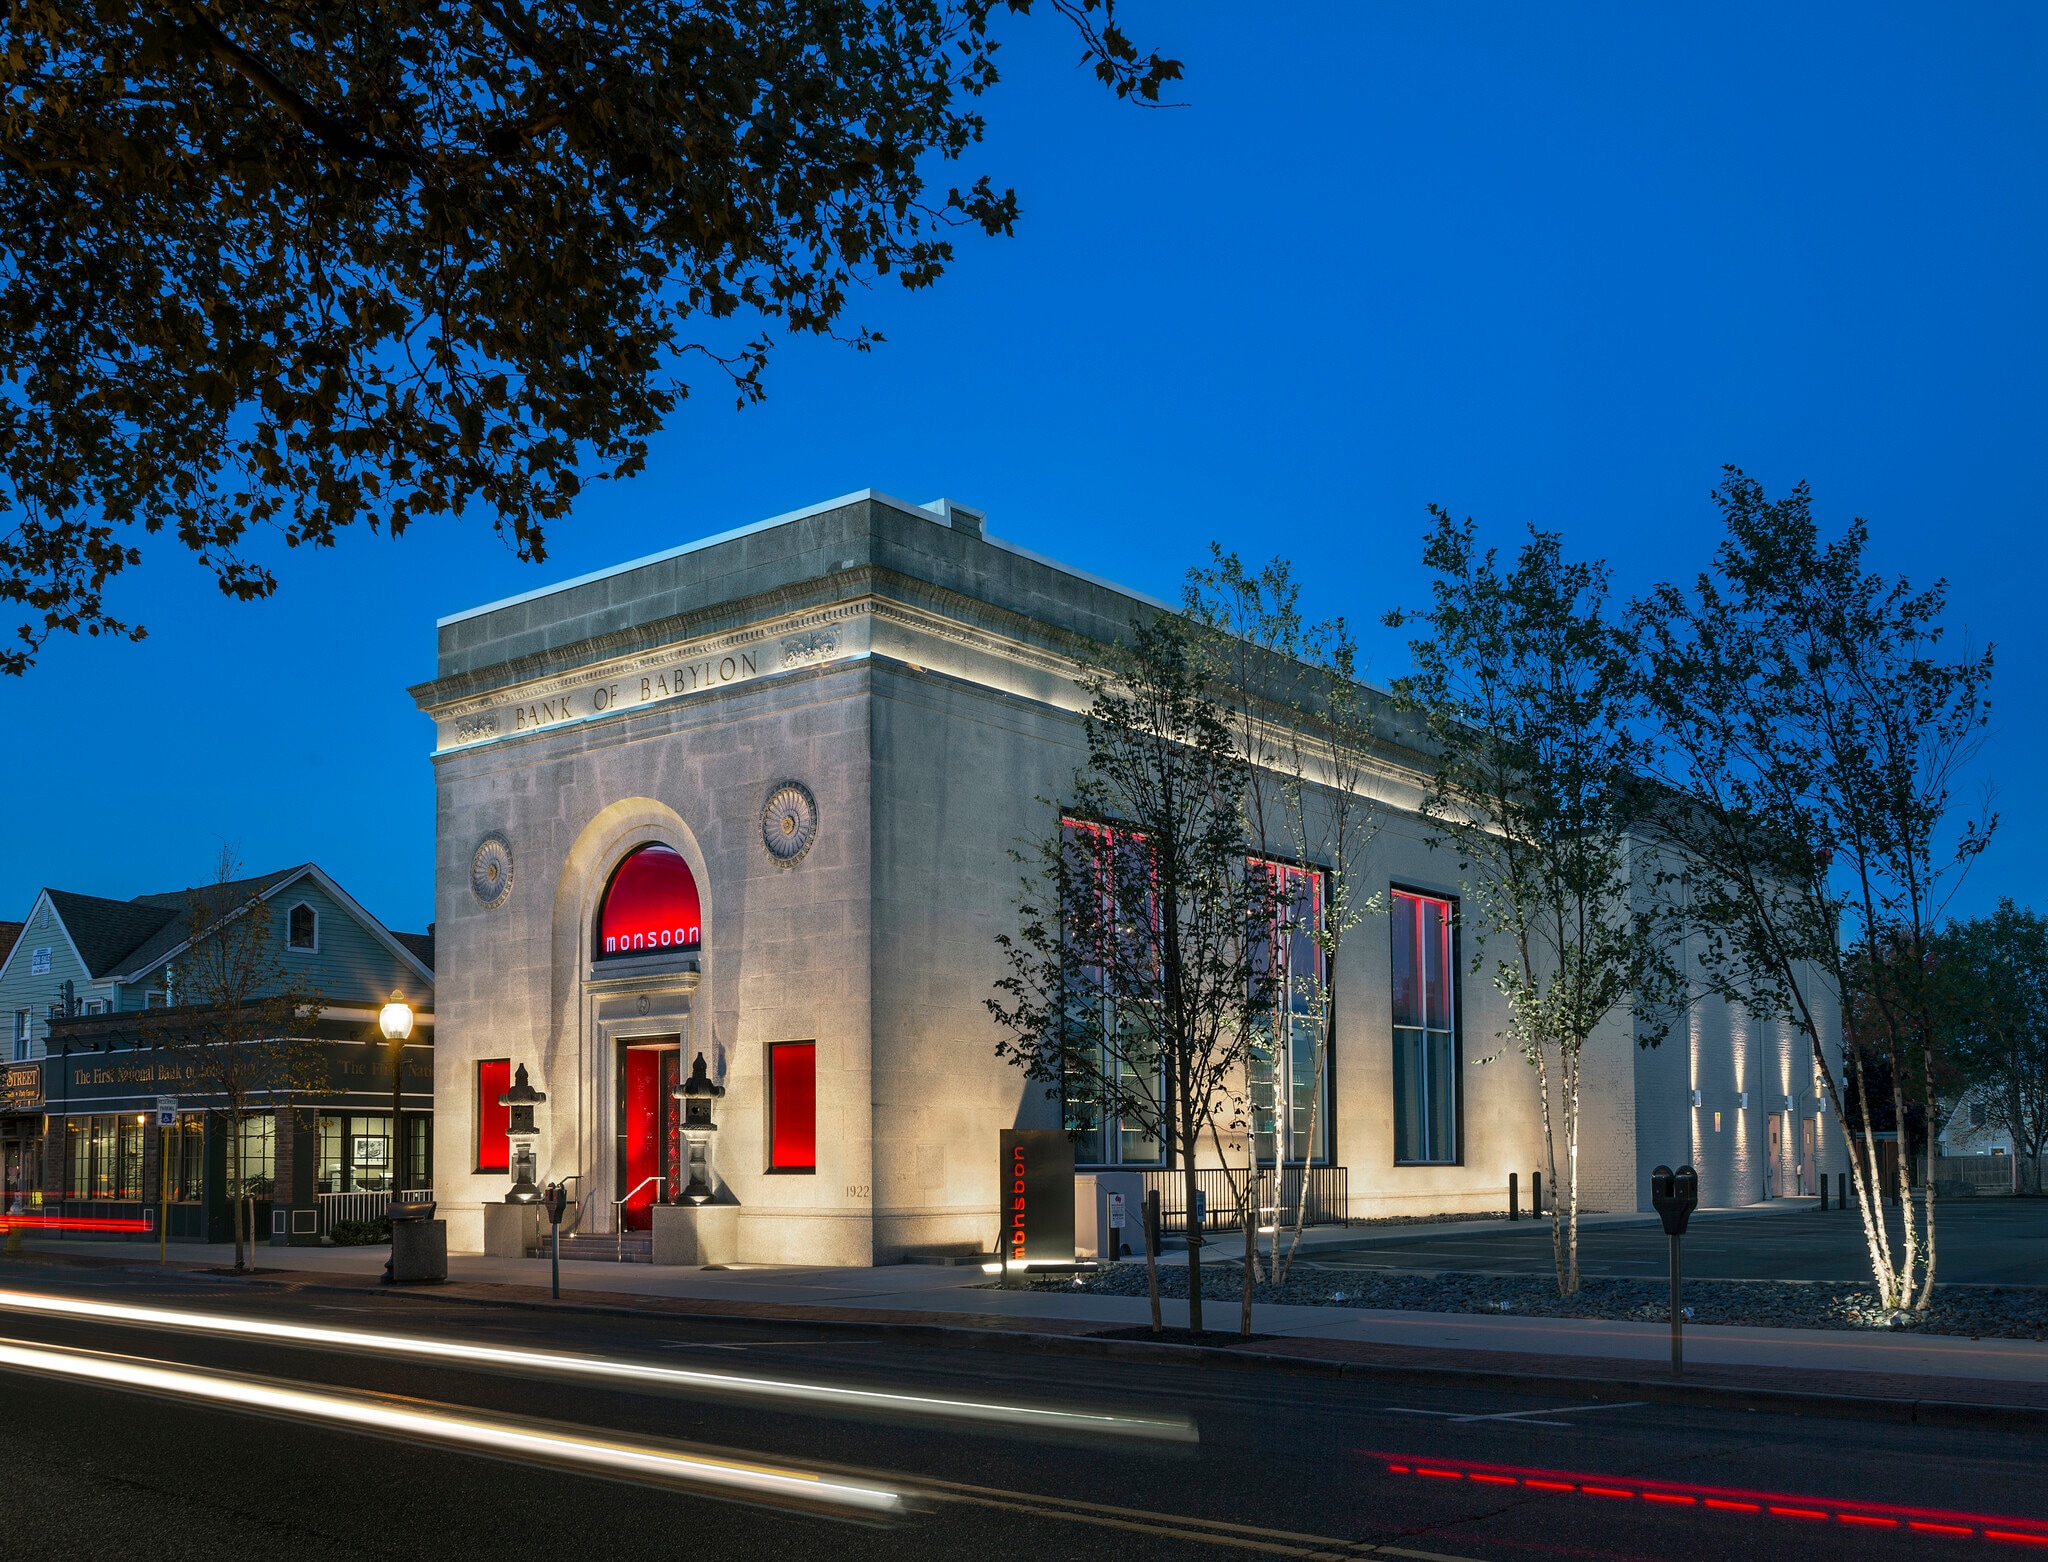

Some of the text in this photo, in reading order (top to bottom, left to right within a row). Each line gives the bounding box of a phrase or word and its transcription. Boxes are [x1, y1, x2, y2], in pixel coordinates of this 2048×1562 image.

[516, 650, 758, 730] BANK OF BABYLON
[606, 926, 699, 953] monsoon
[6, 1070, 37, 1088] STREET
[75, 1069, 91, 1085] The
[93, 1067, 115, 1084] First
[158, 1063, 182, 1081] Bank
[408, 1063, 434, 1079] Nati
[846, 1185, 870, 1198] 1922
[1013, 1145, 1026, 1260] monsoon
